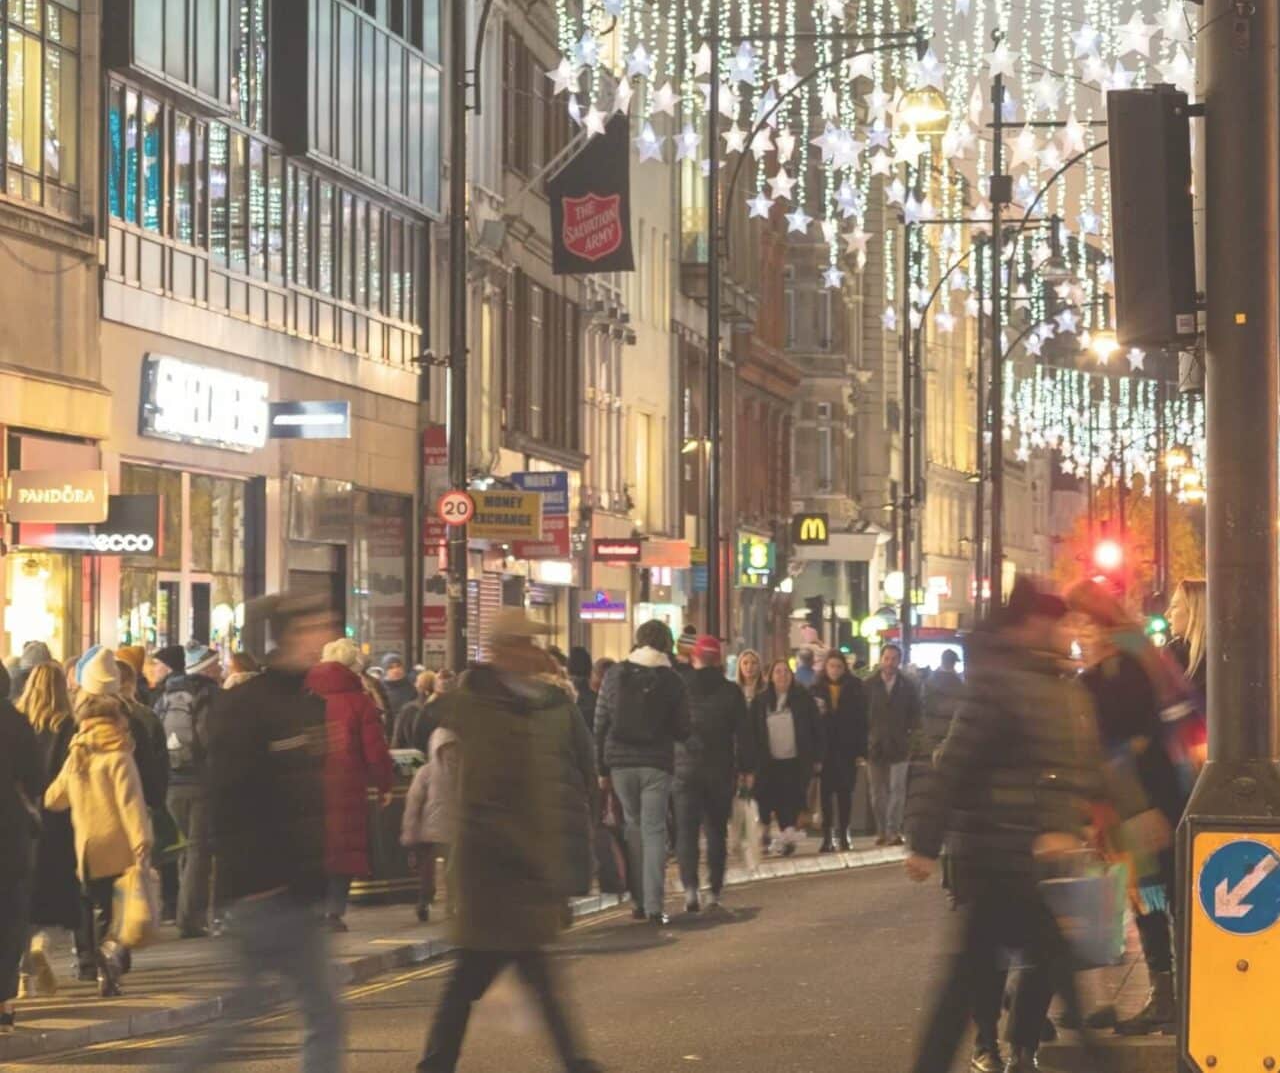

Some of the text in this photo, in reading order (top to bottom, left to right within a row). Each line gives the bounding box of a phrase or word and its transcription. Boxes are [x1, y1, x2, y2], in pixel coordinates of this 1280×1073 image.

[584, 224, 613, 252] ARMY
[444, 501, 467, 515] 20
[95, 533, 154, 552] ecco
